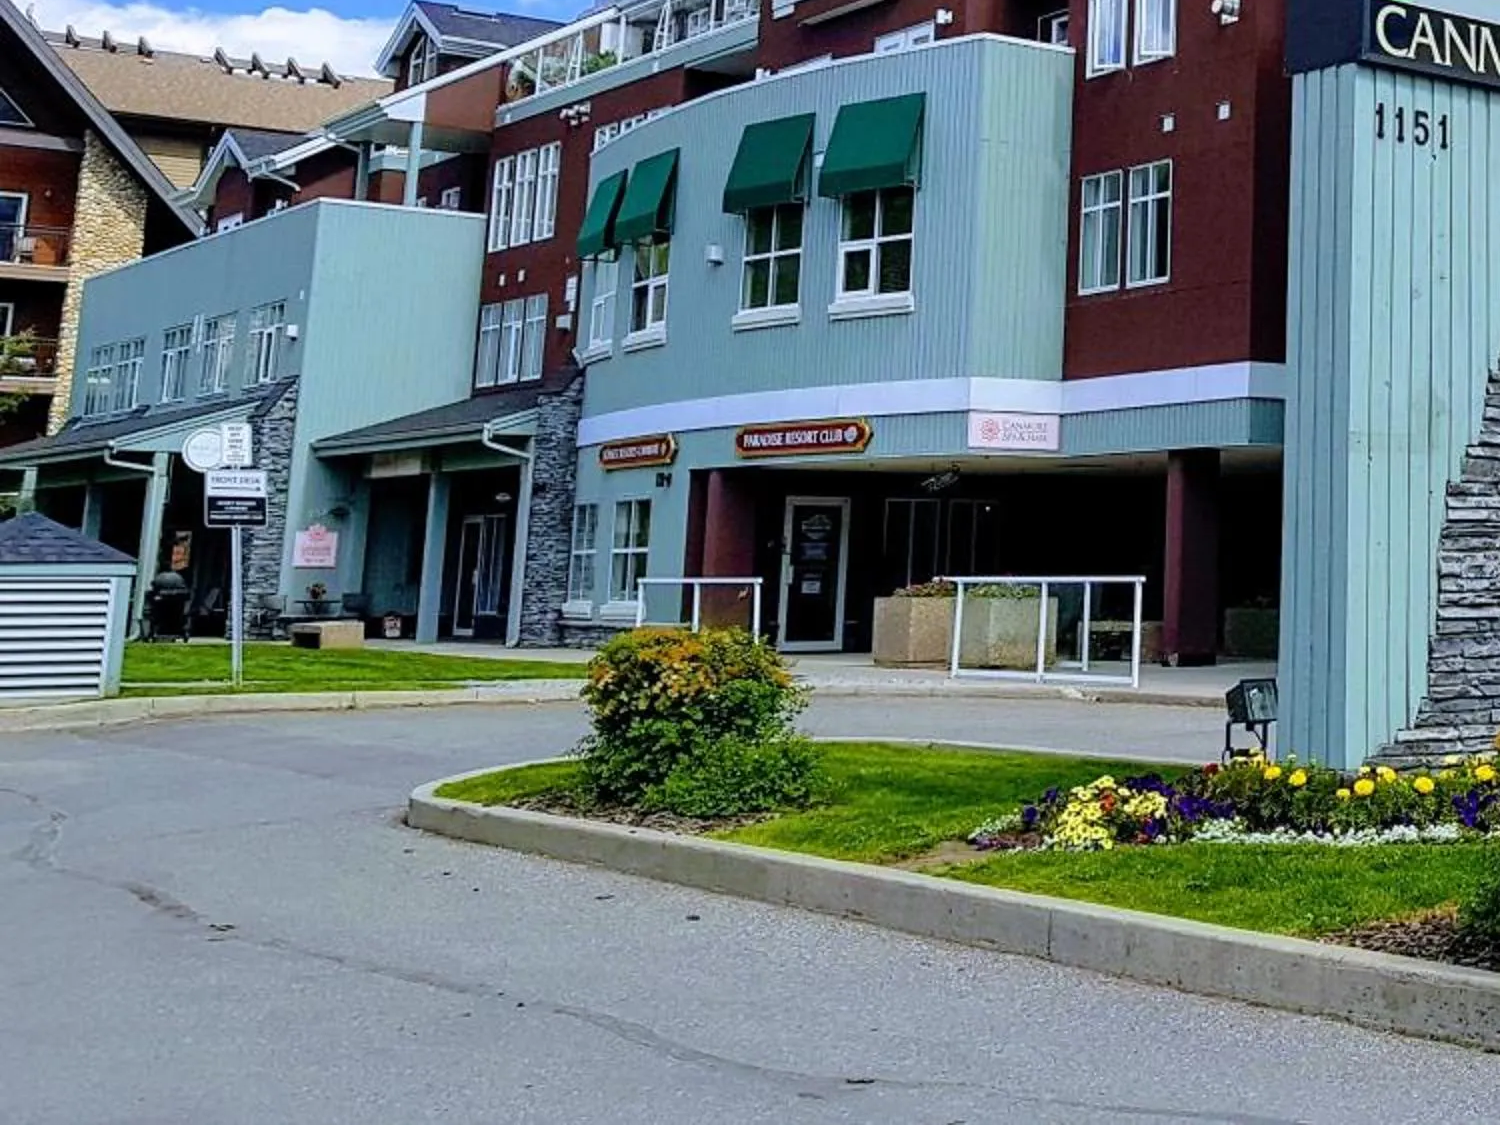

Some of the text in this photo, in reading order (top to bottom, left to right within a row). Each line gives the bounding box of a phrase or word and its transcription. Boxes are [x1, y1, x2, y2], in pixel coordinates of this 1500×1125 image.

[1374, 101, 1449, 150] 1151
[743, 428, 843, 448] PARADISE RESORT CLUB
